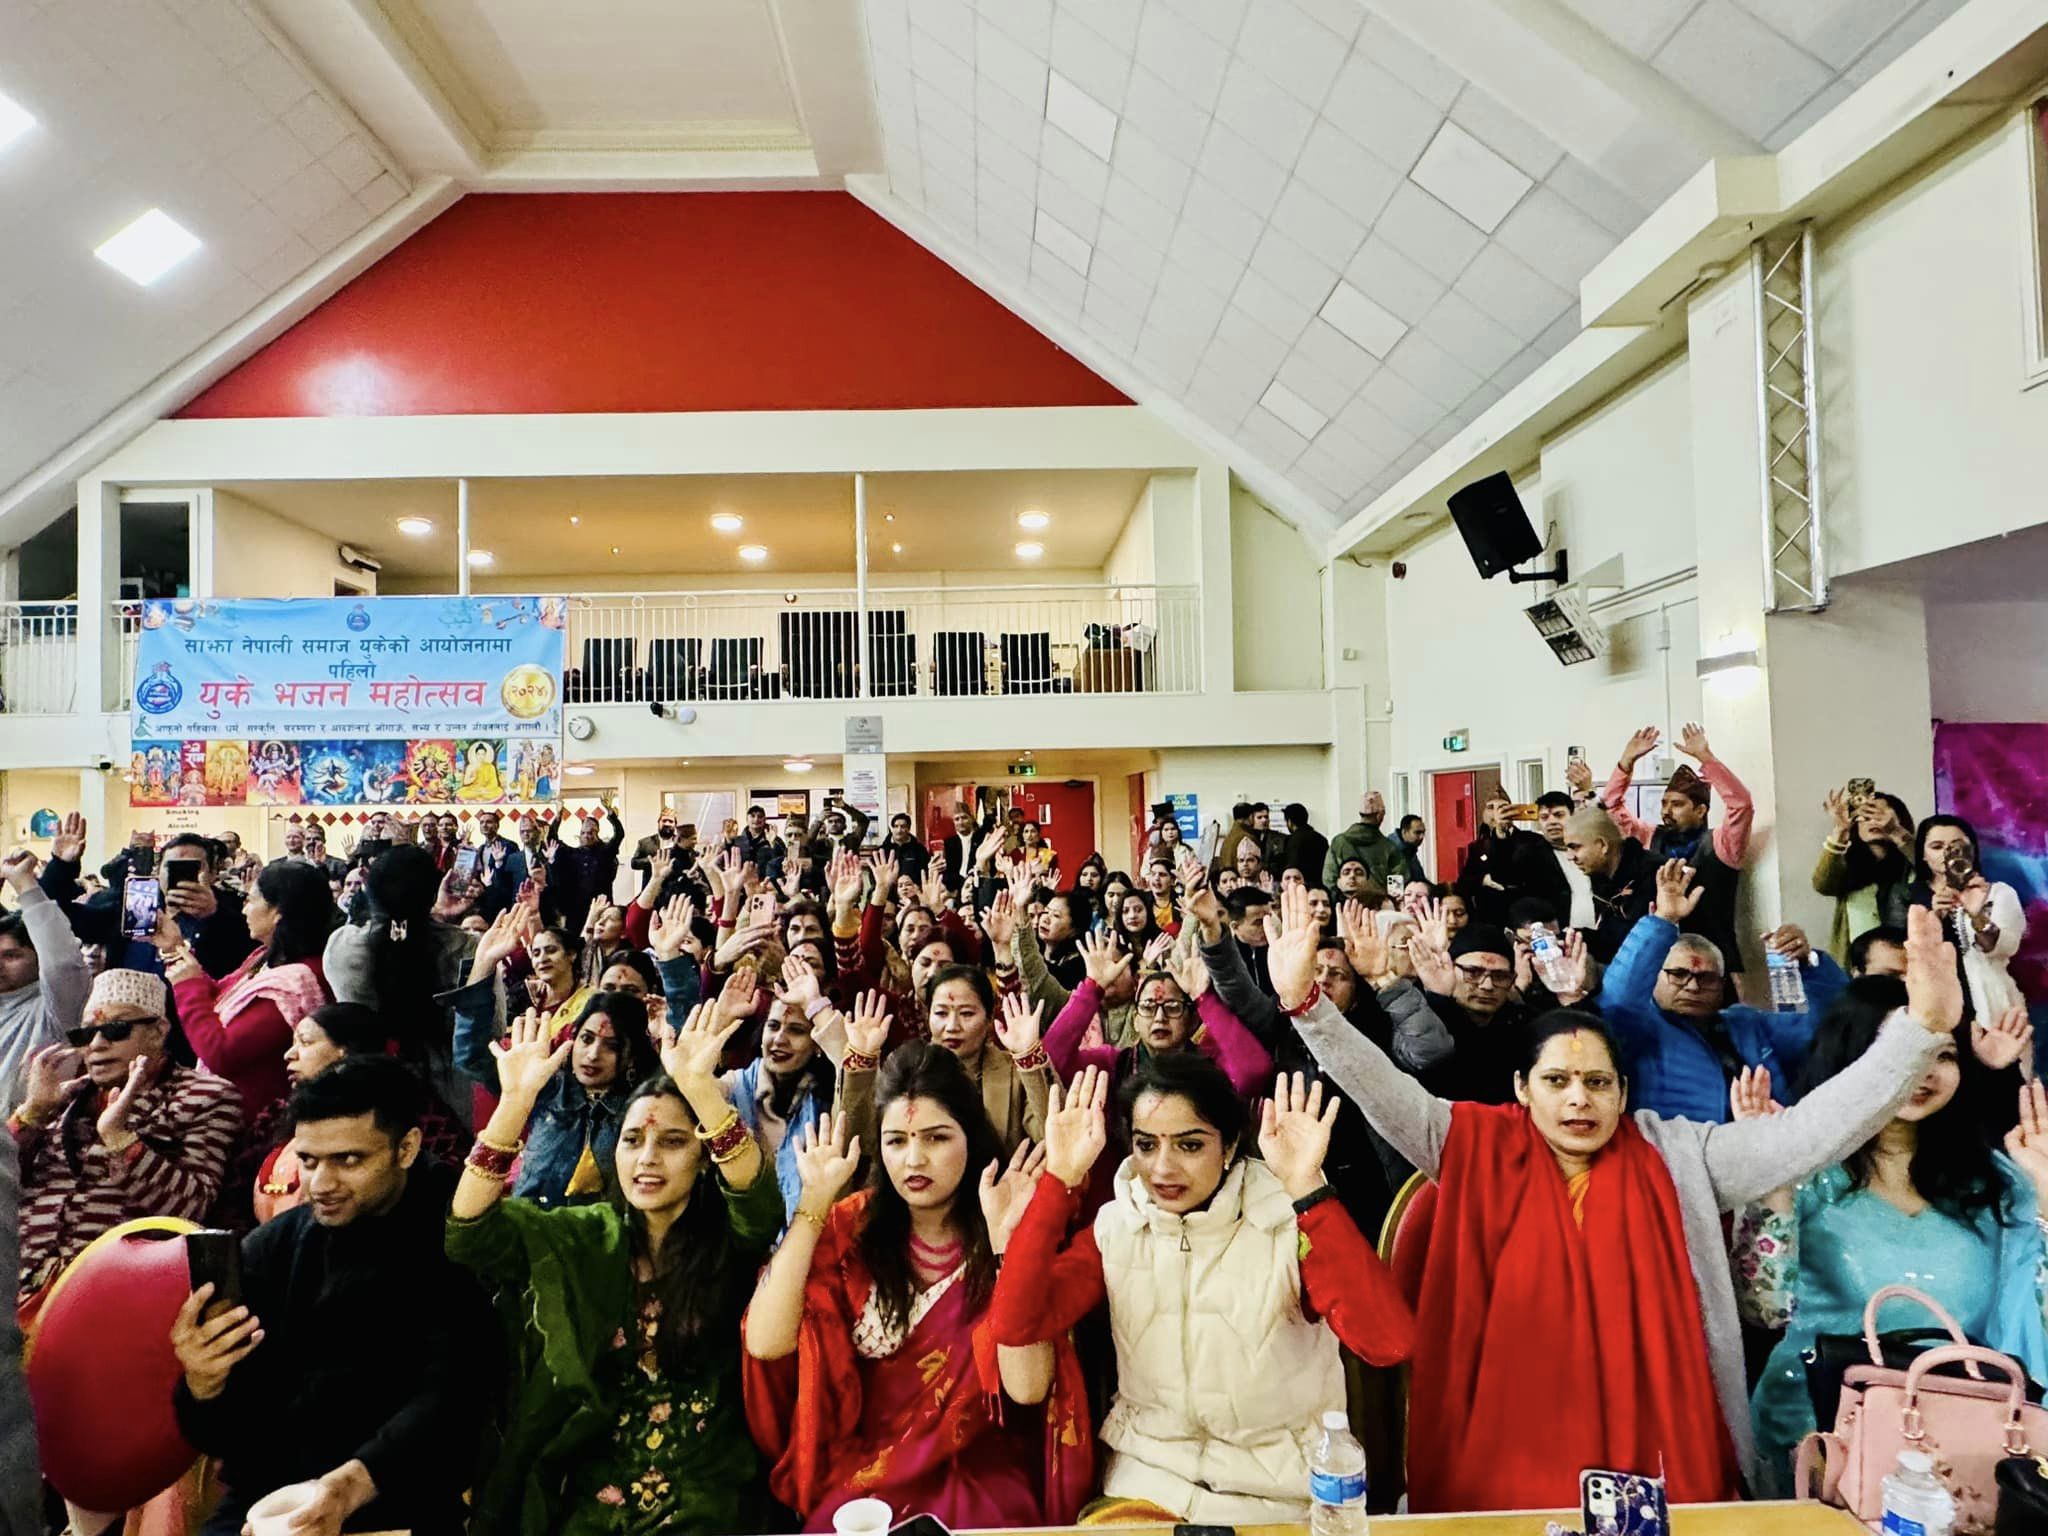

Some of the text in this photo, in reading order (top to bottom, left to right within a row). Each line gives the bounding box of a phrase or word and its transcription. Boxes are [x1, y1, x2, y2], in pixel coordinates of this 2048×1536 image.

[242, 634, 293, 654] नेपाली
[301, 639, 351, 654] समाज
[360, 635, 410, 659] युकेको
[419, 635, 512, 653] आयोजनामा
[328, 659, 376, 681] पहिलो
[200, 674, 487, 720] युके भजन महोत्सव
[511, 685, 545, 698] २०२४
